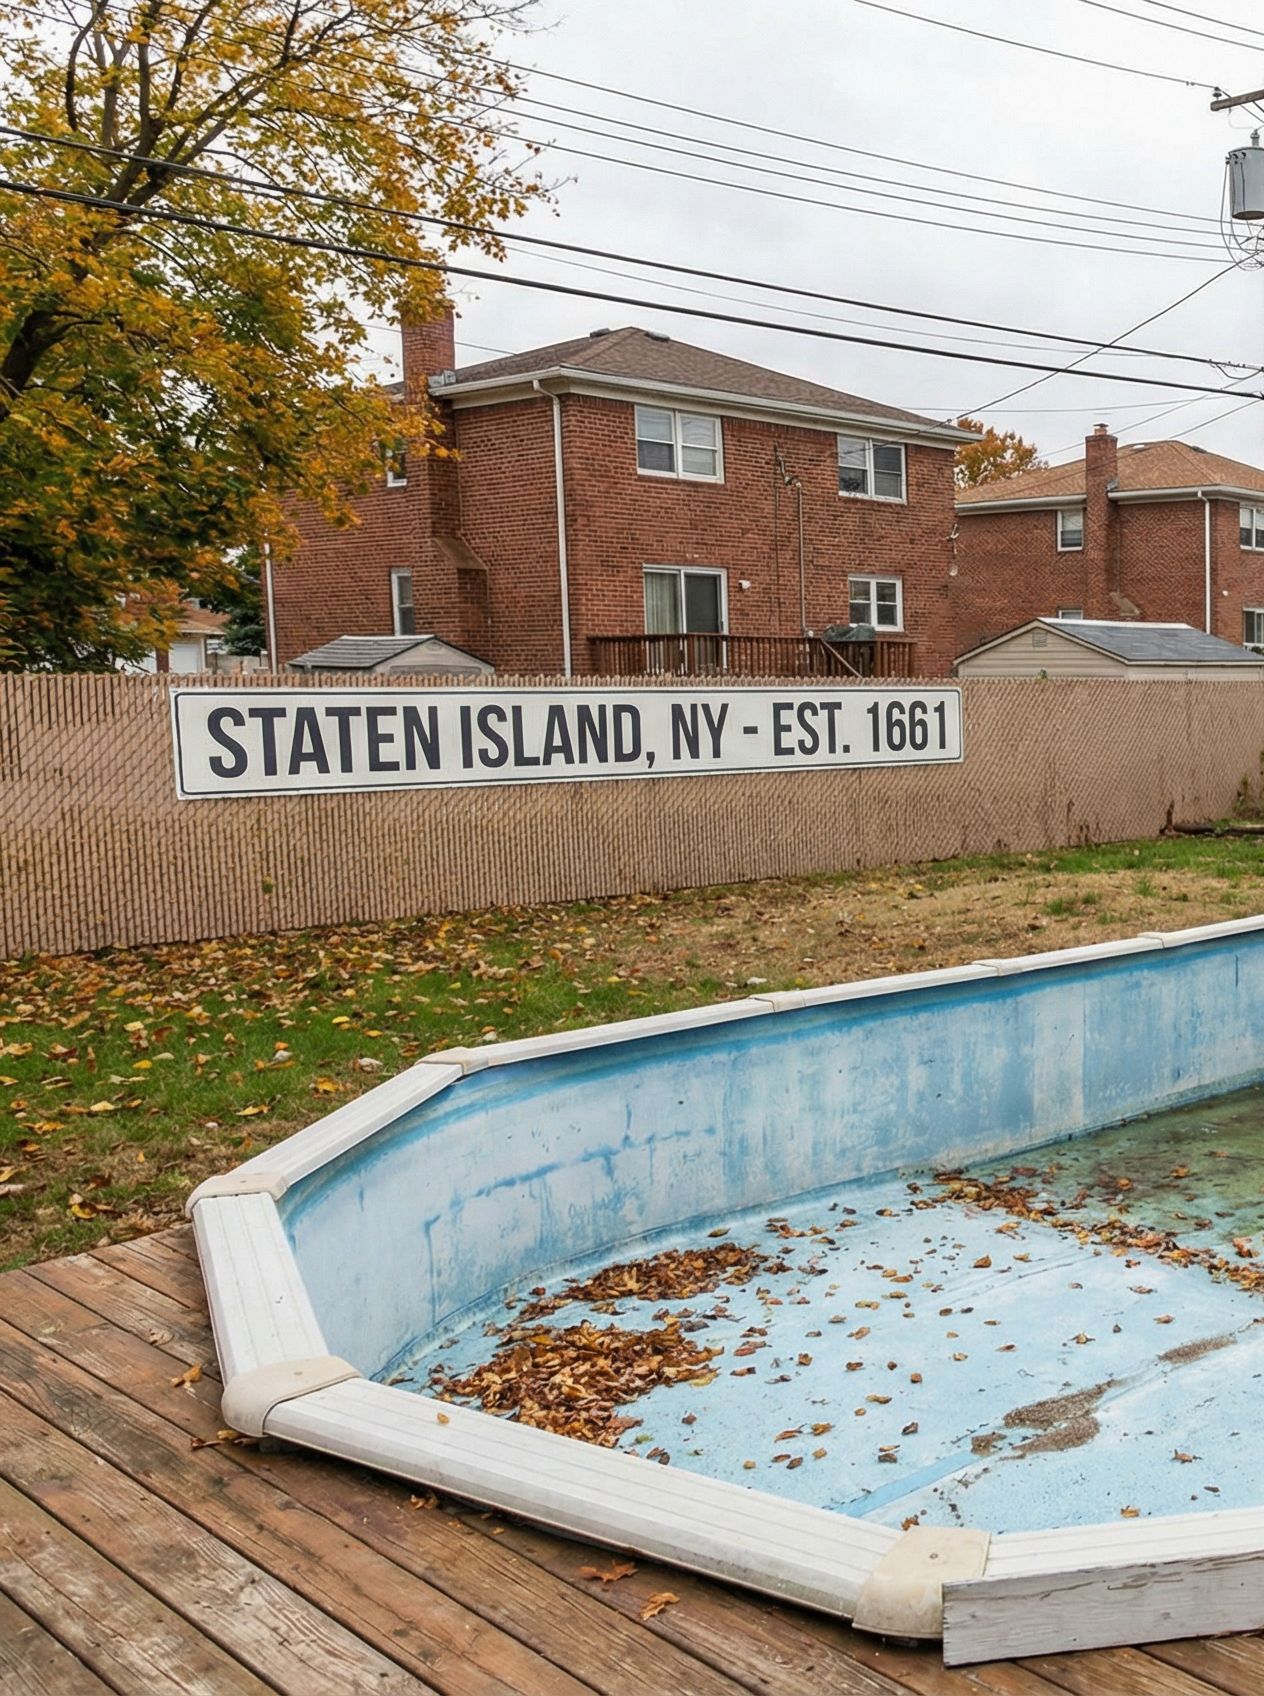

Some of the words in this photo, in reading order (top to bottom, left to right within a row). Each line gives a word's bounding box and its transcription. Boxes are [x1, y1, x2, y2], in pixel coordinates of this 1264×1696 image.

[207, 706, 441, 779] STATEN
[459, 704, 656, 769] ISLAND,
[671, 703, 729, 760] NY
[772, 701, 851, 757] EST.
[866, 700, 946, 754] 1661
